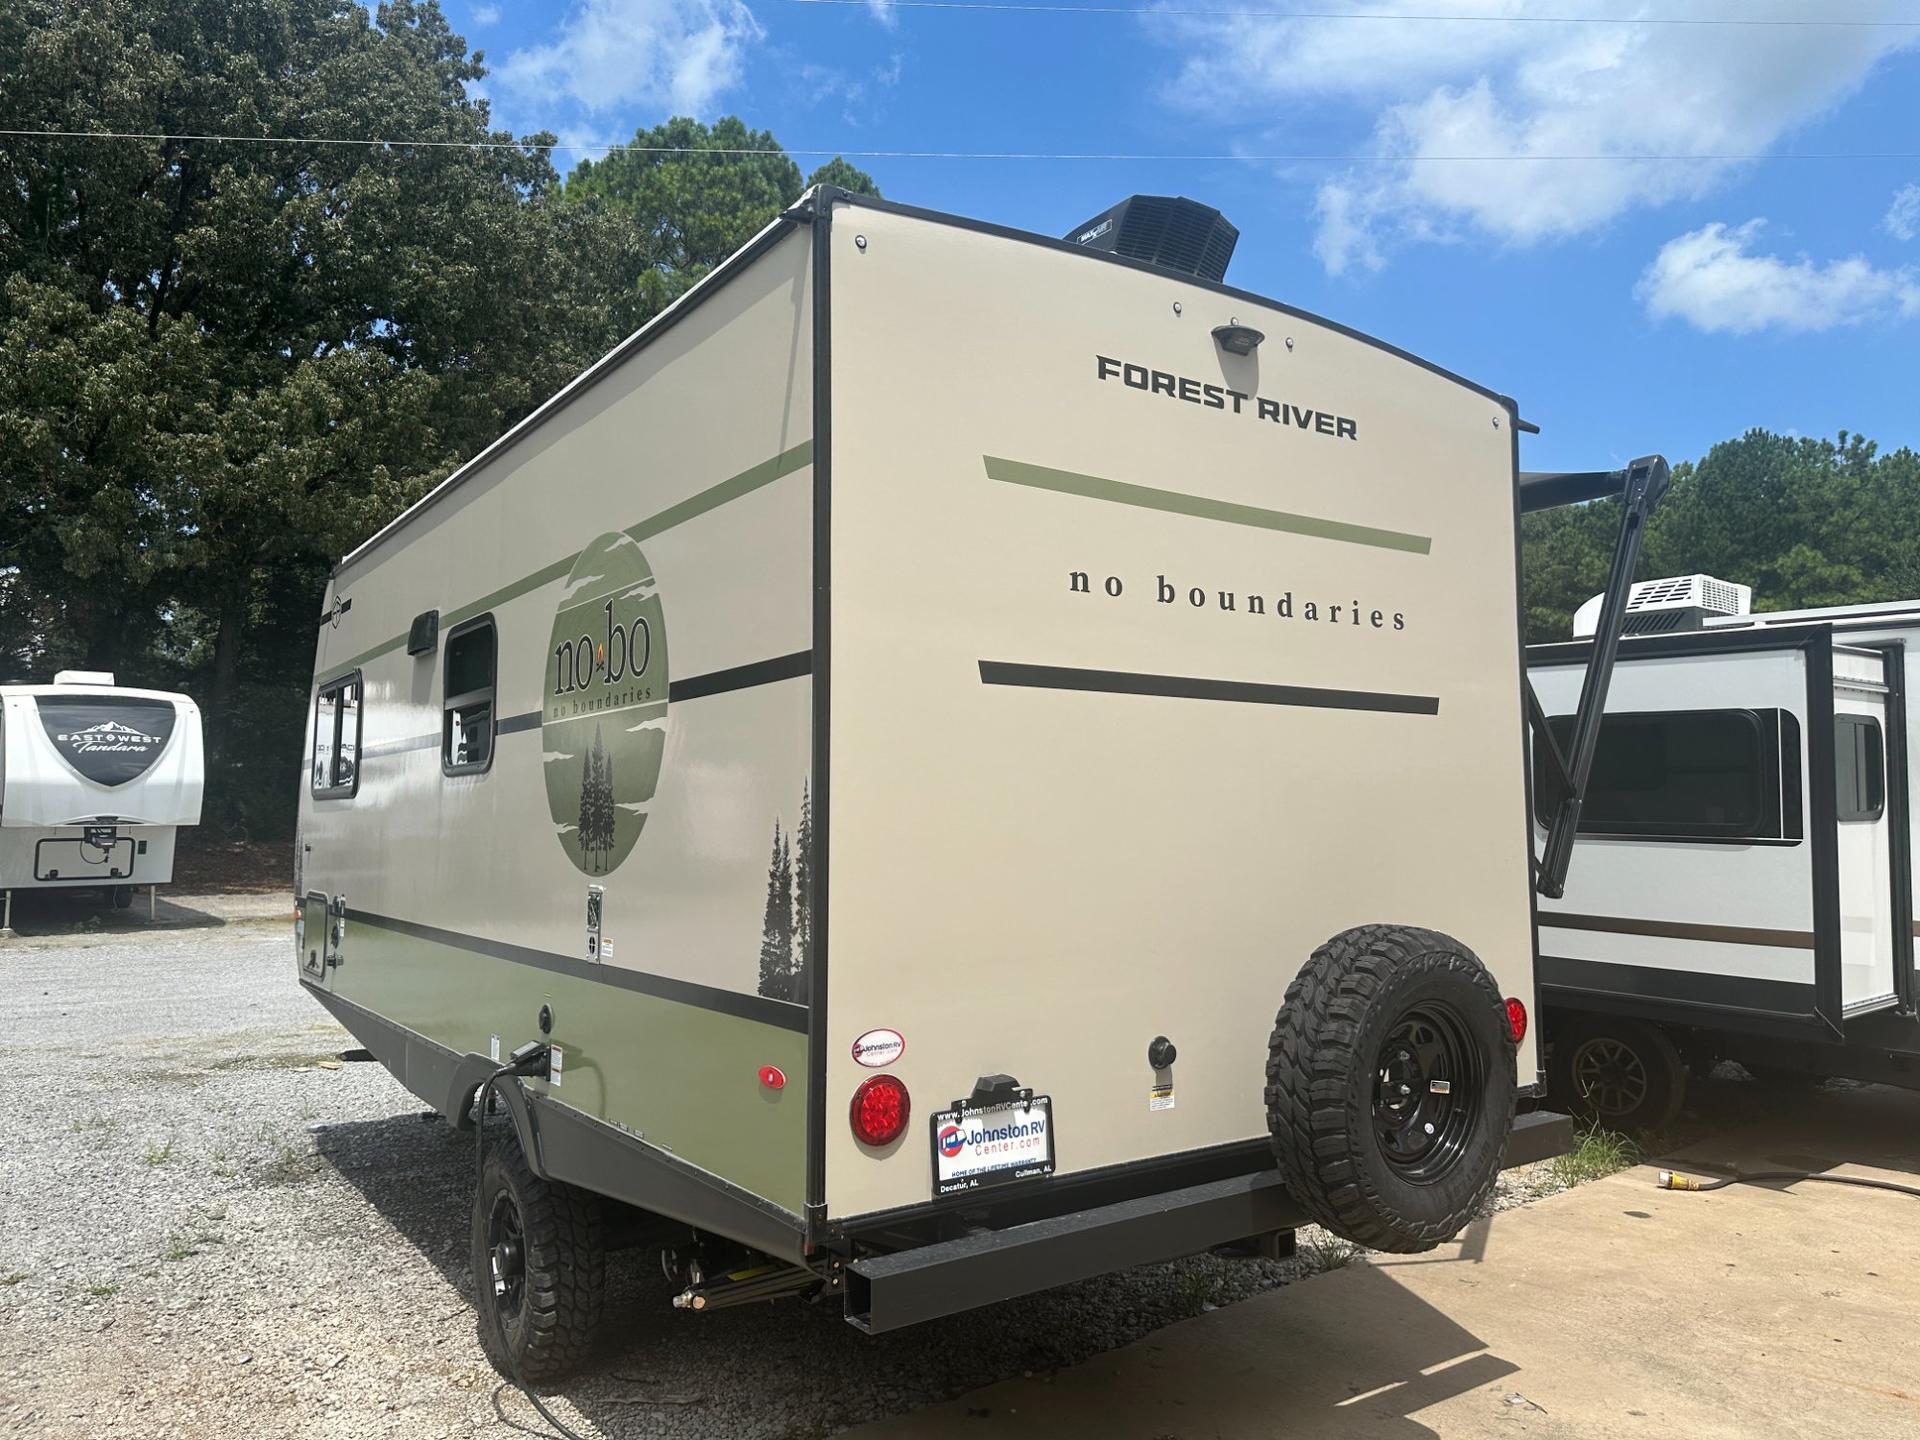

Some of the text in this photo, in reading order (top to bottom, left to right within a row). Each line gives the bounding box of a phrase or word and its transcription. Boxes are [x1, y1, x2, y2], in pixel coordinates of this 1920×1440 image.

[1096, 355, 1358, 441] FOREST RIVER
[1069, 570, 1405, 630] no boundaries
[553, 687, 652, 718] no boundaries
[57, 734, 161, 744] EAST WEST
[967, 1120, 1045, 1146] Johnston RV
[975, 1136, 1041, 1156] Center.com
[951, 1168, 967, 1178] HOME
[976, 1166, 987, 1174] THE
[987, 1162, 1010, 1173] LIFETIME
[1043, 1164, 1052, 1172] AL
[940, 1179, 979, 1193] Decatur, AL
